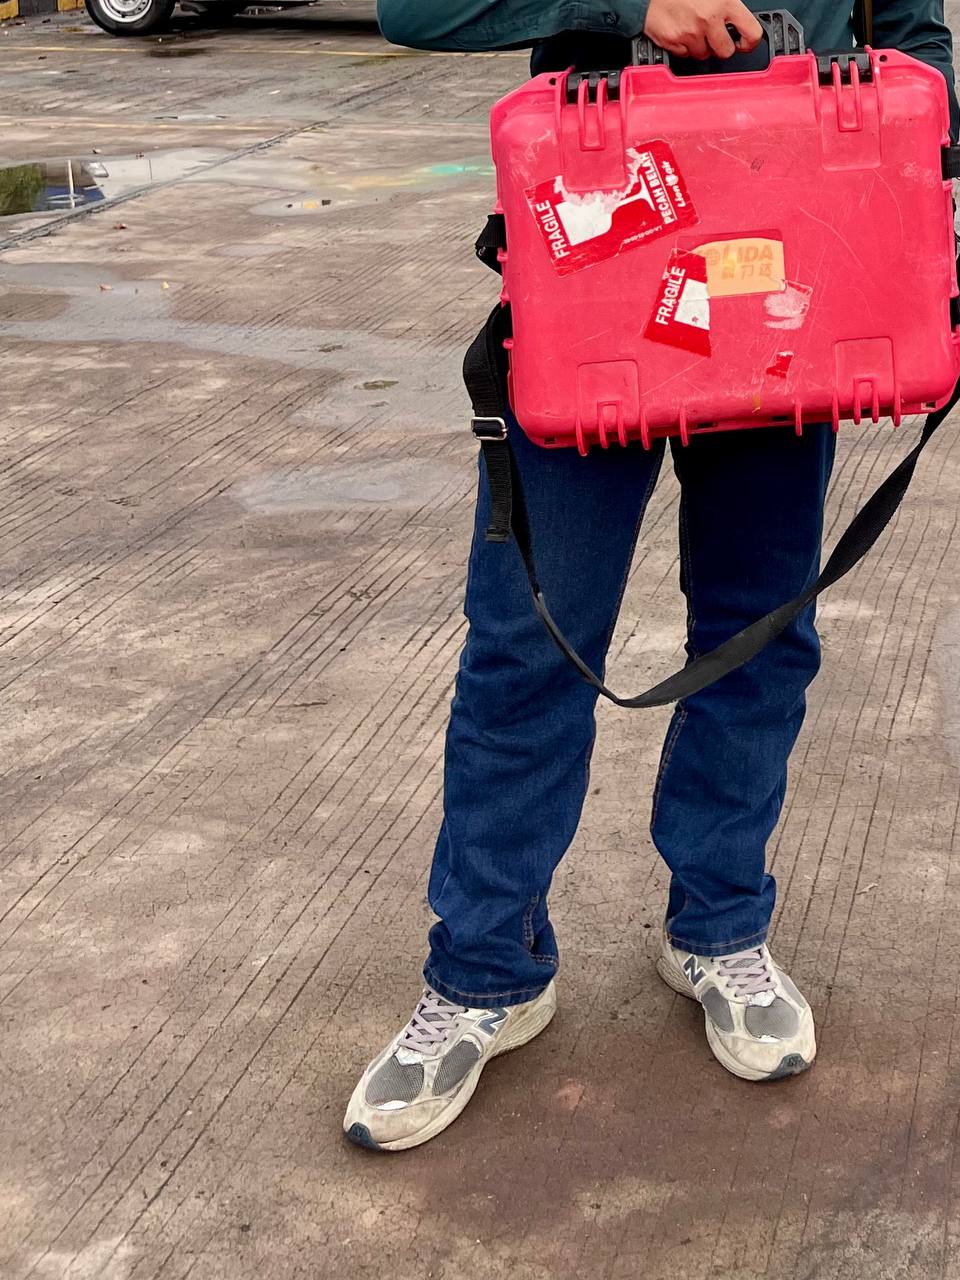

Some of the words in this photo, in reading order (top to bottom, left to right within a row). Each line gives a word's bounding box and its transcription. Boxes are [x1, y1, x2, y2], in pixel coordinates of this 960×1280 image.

[642, 152, 661, 188] BELAH
[536, 199, 571, 260] FRAGILE
[653, 189, 676, 225] PECAH
[655, 266, 686, 325] FRAGILE
